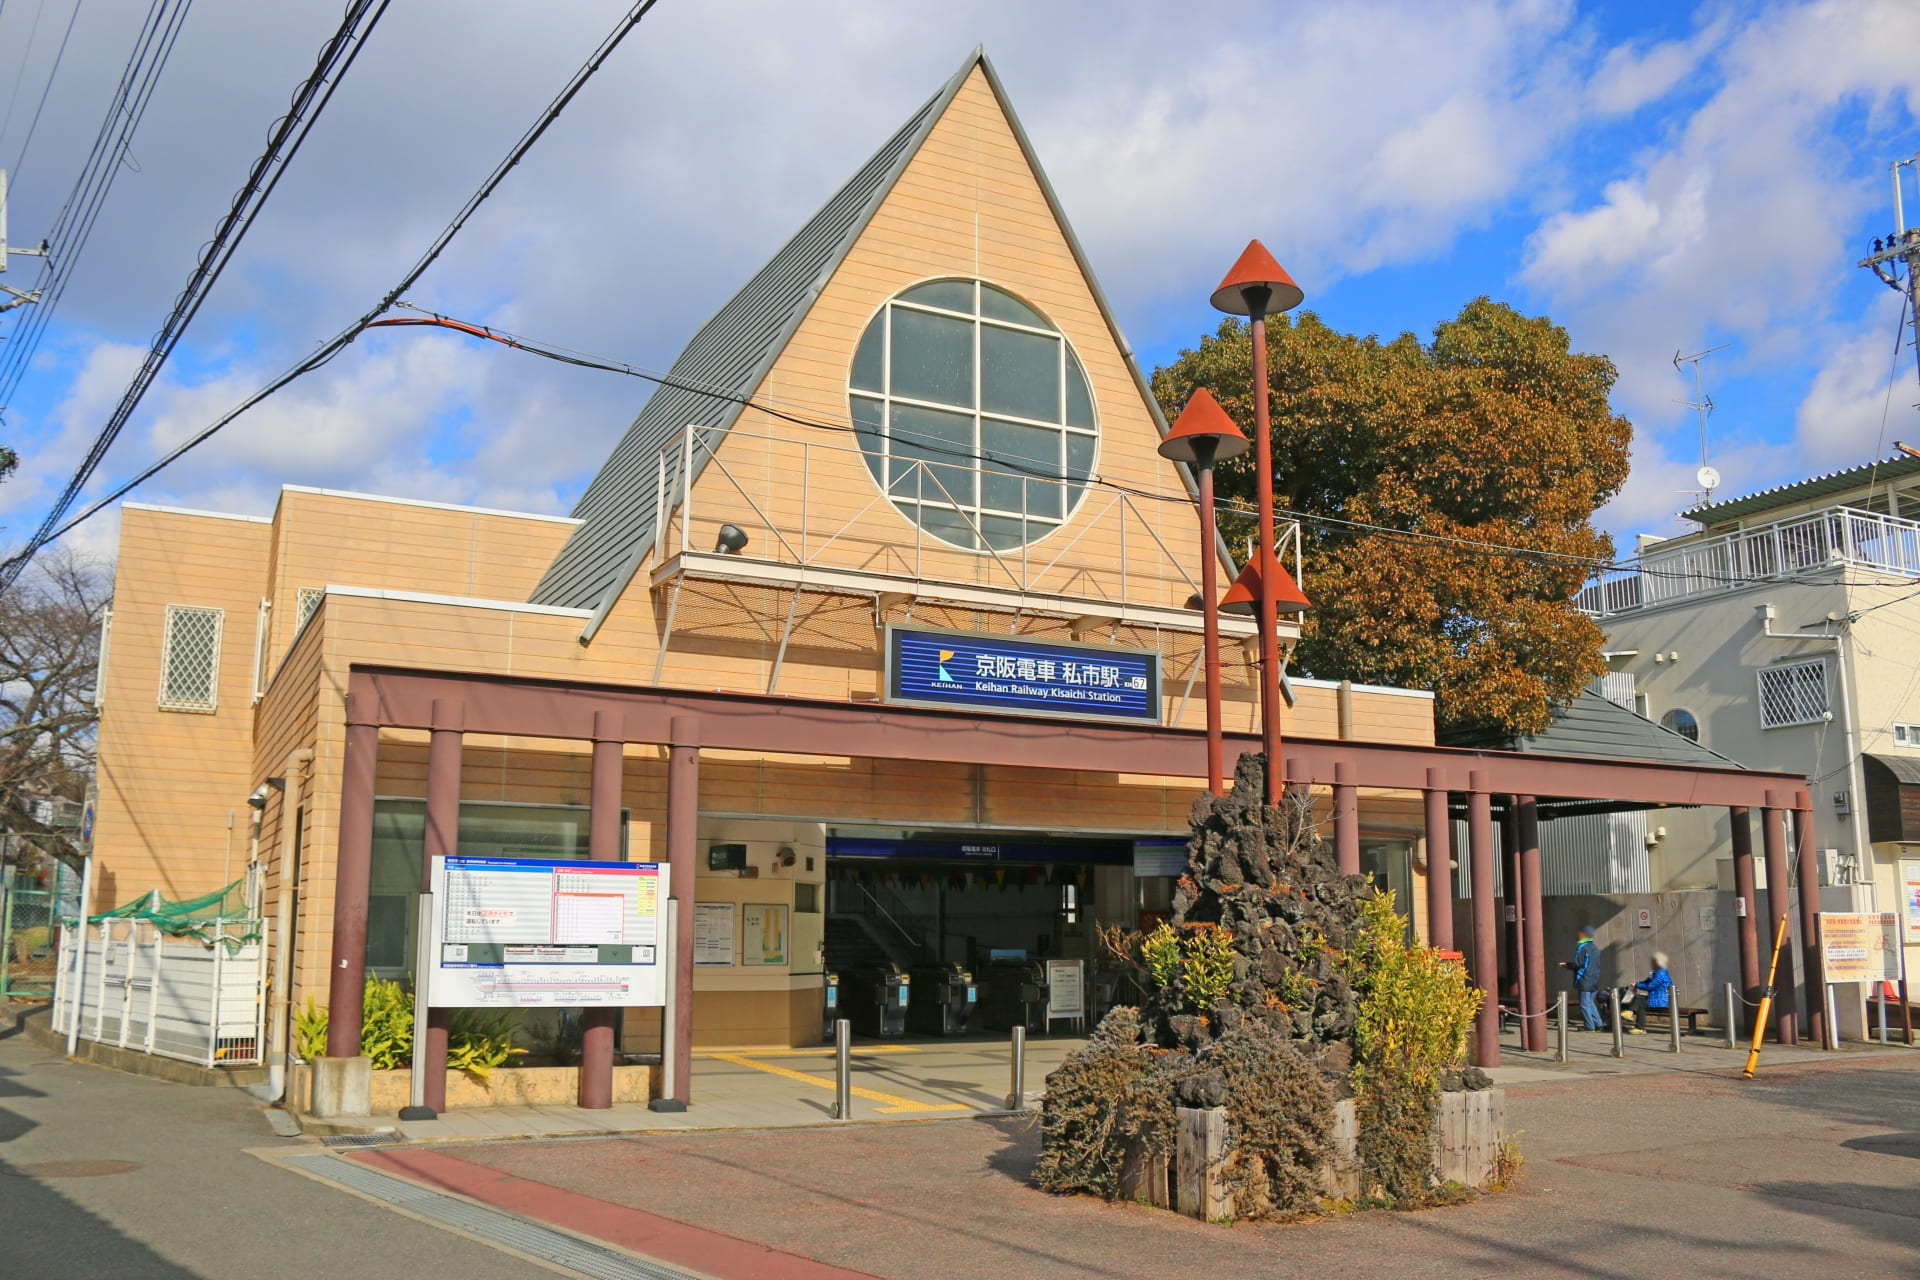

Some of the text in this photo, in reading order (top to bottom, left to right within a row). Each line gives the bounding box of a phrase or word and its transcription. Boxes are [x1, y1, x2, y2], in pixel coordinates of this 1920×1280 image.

[975, 654, 1120, 689] 京阪電車 私市駅
[931, 681, 963, 690] KEIHAN
[1133, 678, 1145, 689] 67
[975, 681, 1121, 703] Keihan Railway Kisaichi Station
